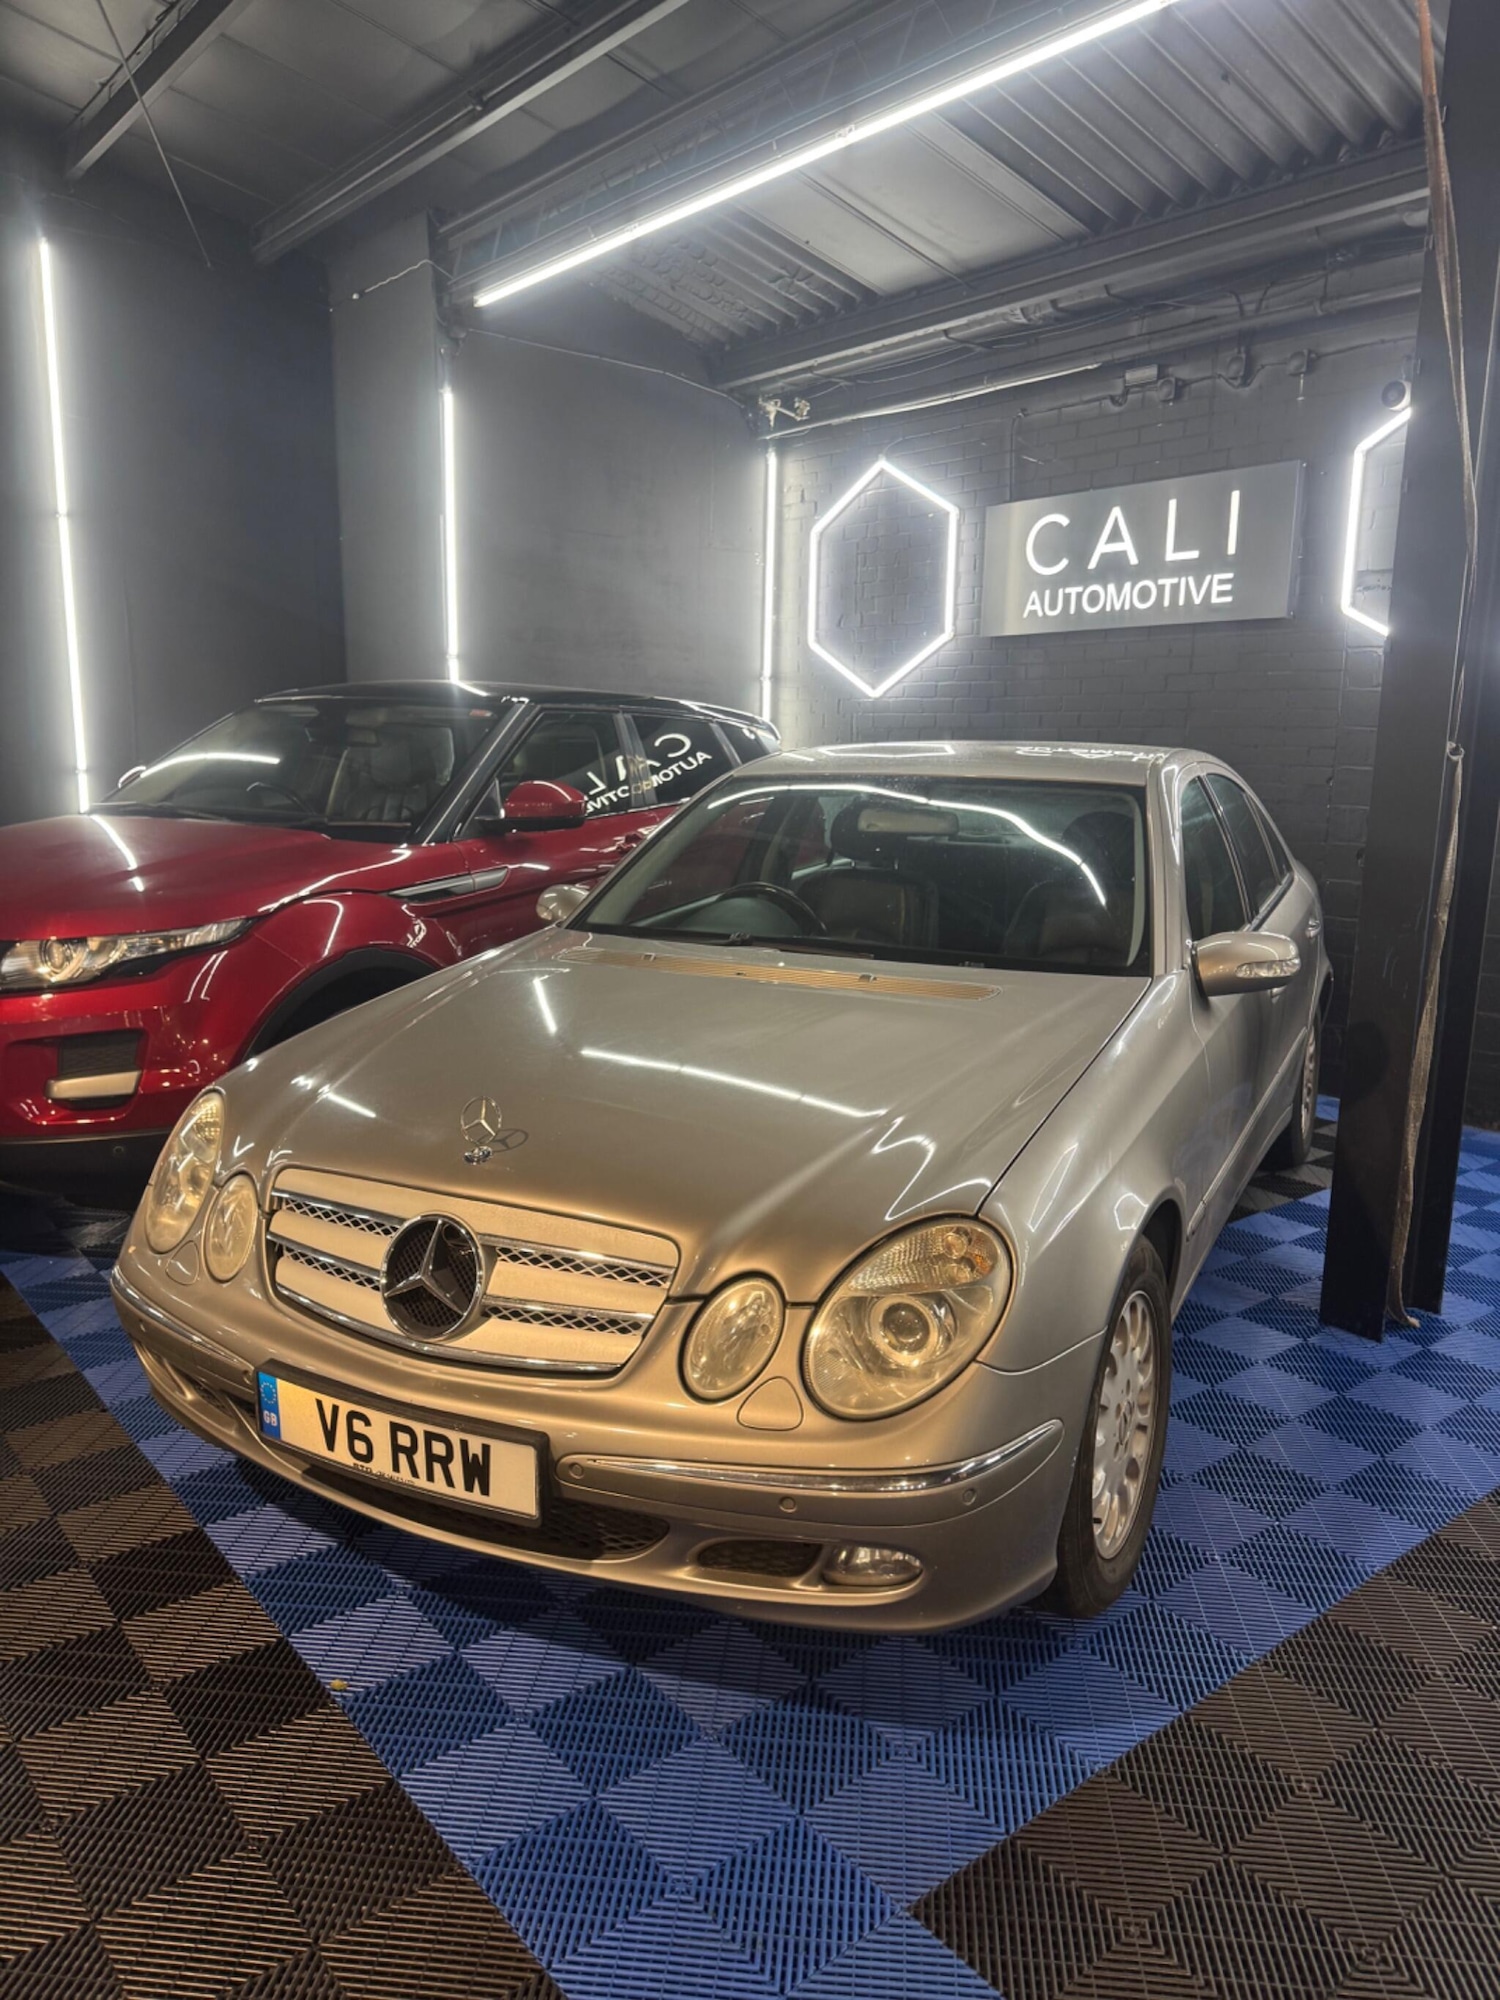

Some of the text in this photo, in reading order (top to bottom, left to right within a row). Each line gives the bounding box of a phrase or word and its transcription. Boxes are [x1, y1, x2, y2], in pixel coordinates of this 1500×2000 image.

[1025, 490, 1240, 576] CALI
[1023, 573, 1234, 619] AUTOMOTIVE
[263, 1410, 278, 1427] GB
[315, 1398, 491, 1497] V6 RRW
